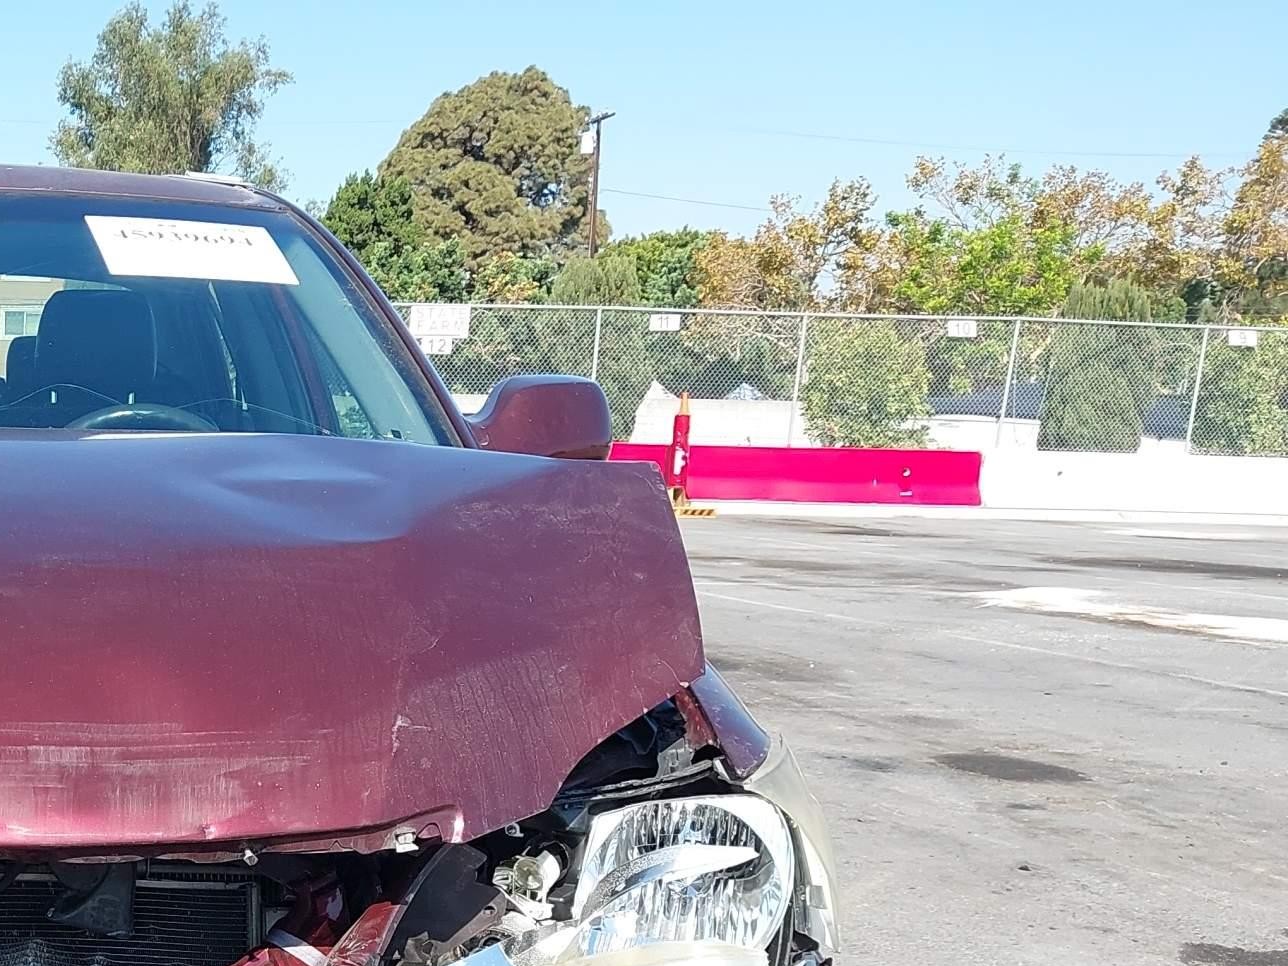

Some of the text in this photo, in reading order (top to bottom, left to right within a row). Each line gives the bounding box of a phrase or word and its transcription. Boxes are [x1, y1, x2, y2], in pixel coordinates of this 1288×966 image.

[416, 307, 467, 320] STATE
[416, 320, 467, 332] FARM
[658, 315, 669, 328] 11
[955, 322, 970, 336] 10
[428, 338, 447, 353] 12
